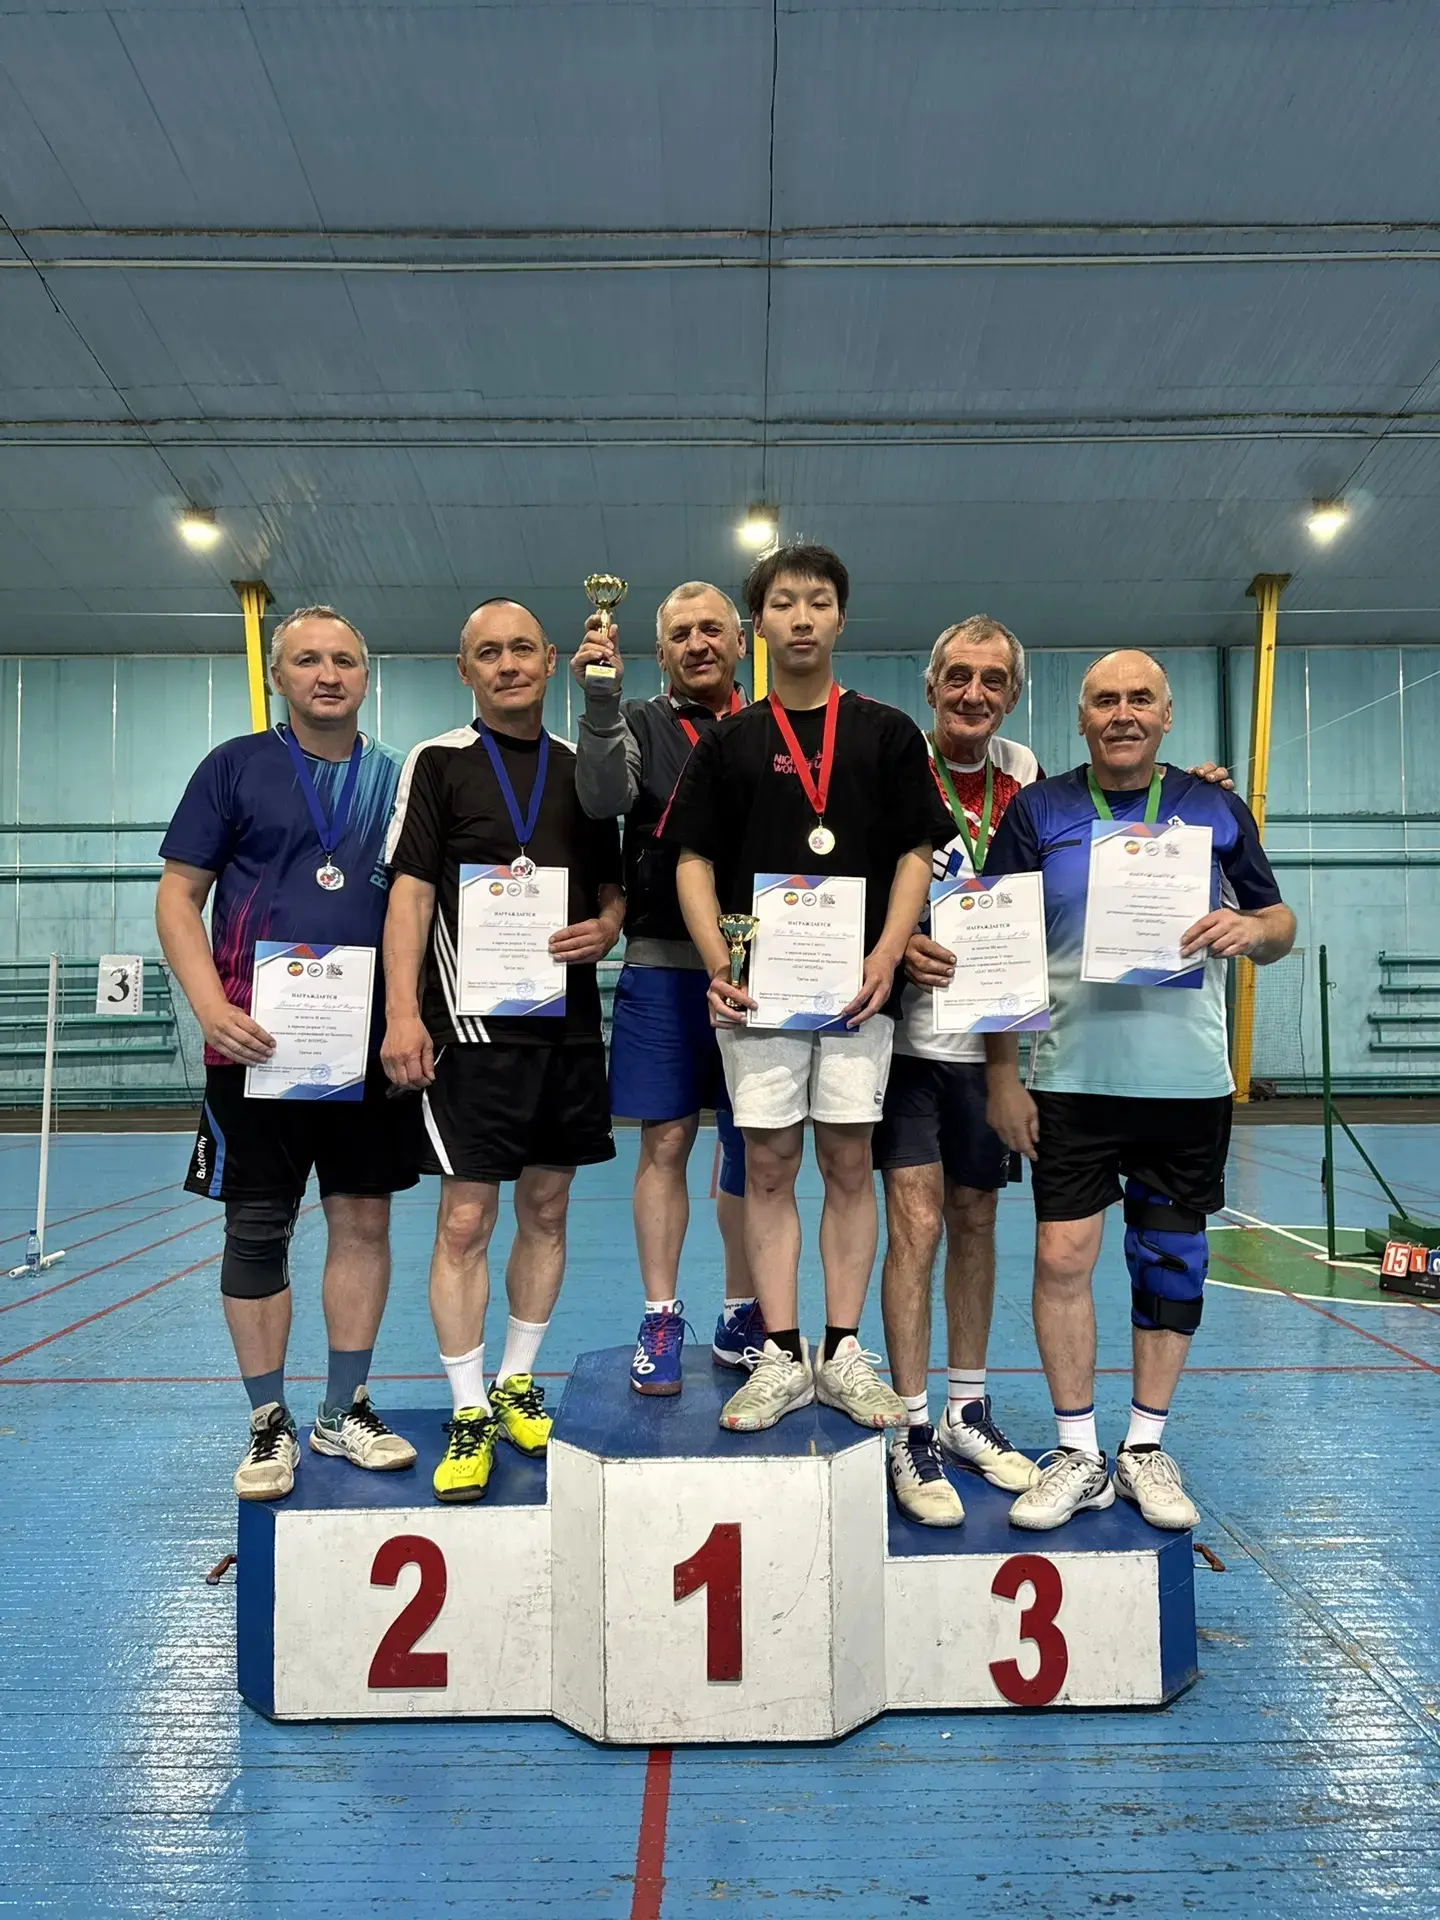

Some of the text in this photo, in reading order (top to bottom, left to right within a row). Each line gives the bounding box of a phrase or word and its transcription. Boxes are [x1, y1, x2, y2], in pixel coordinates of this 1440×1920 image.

[107, 968, 130, 1003] 3
[196, 1135, 208, 1180] Butterfly
[1387, 1247, 1409, 1272] 15
[1415, 1256, 1422, 1271] 1
[367, 1534, 448, 1689] 2
[673, 1522, 742, 1682] 1
[988, 1553, 1068, 1707] 3
